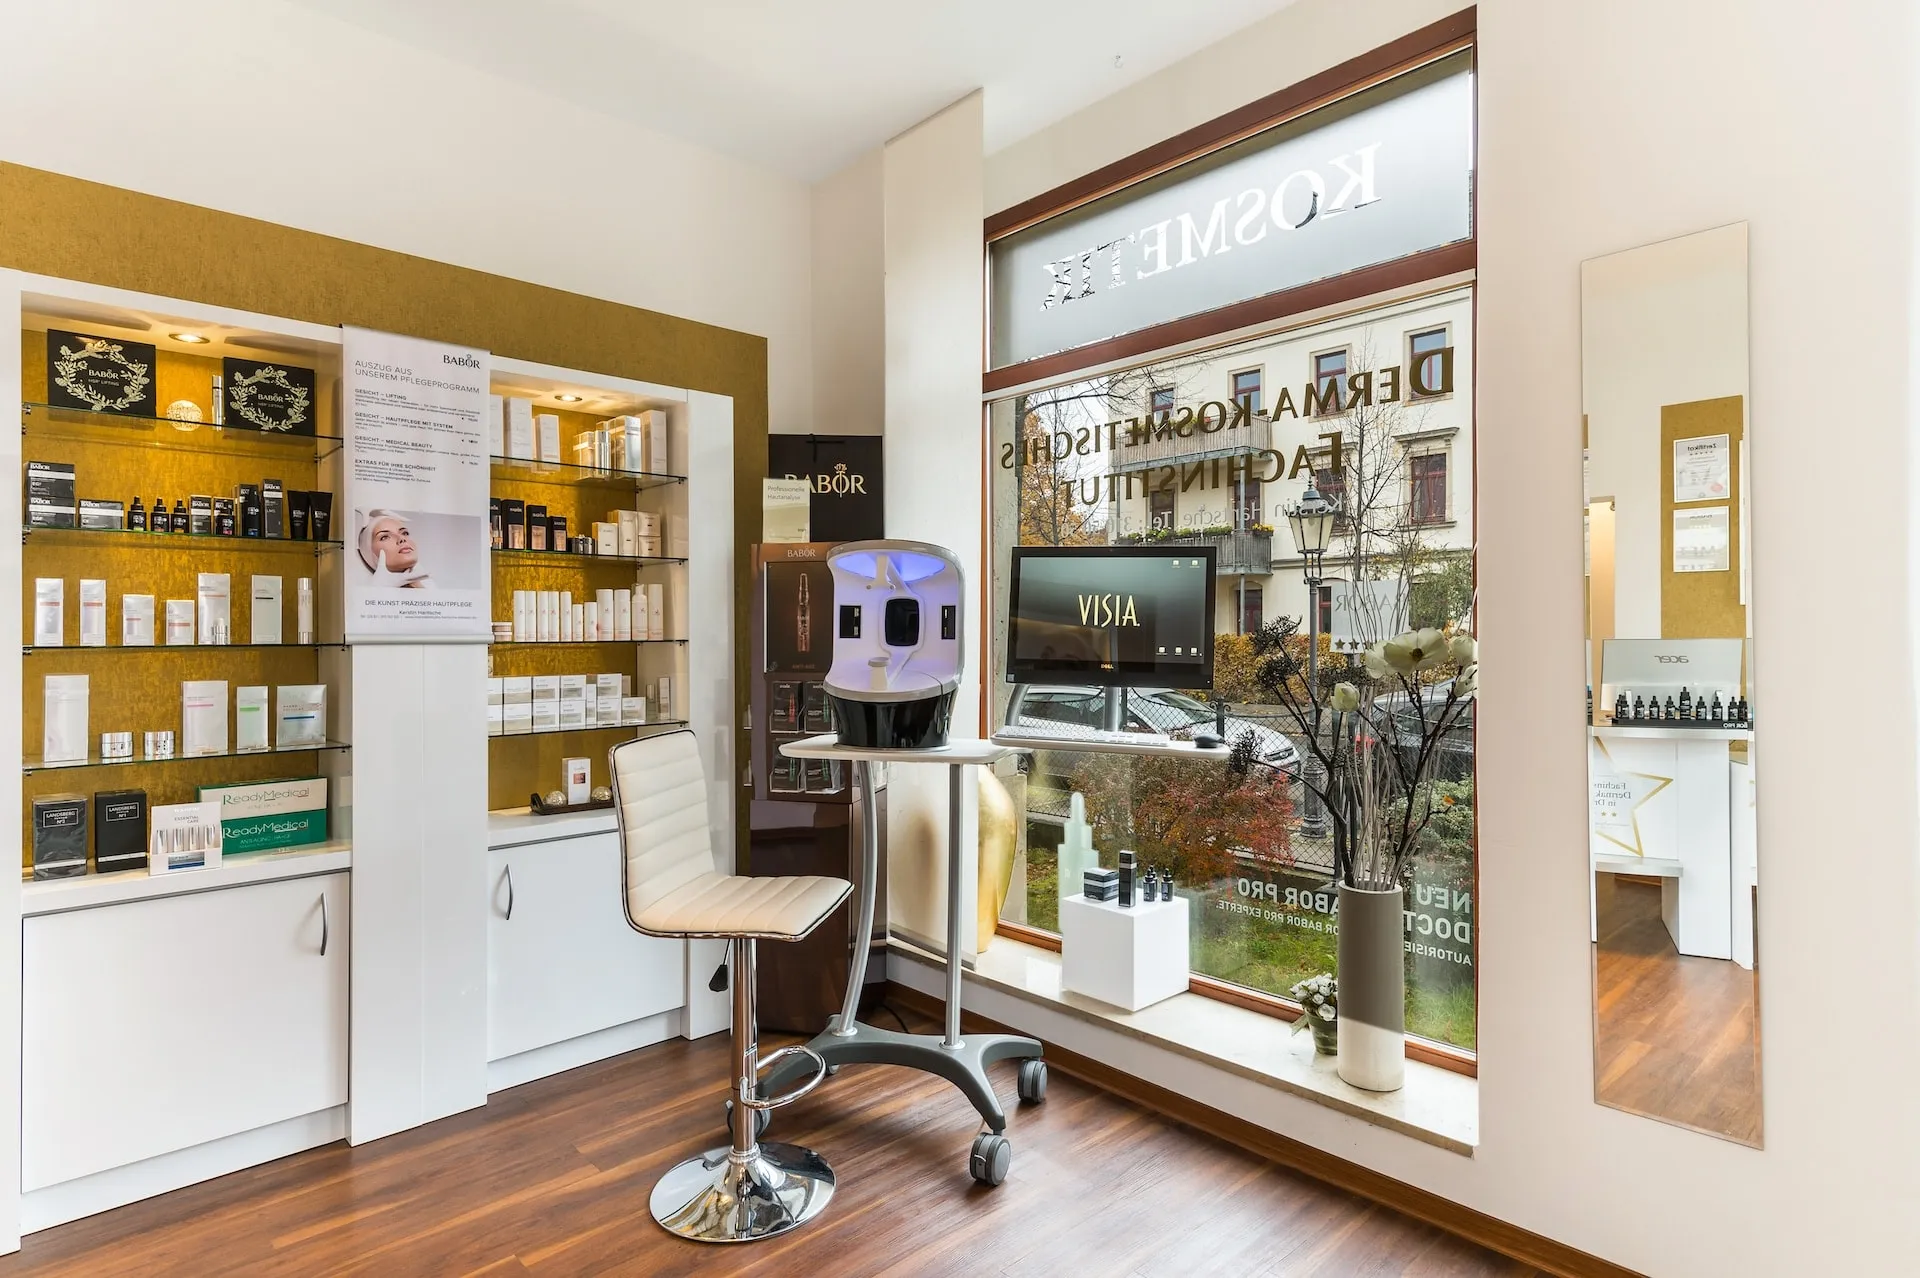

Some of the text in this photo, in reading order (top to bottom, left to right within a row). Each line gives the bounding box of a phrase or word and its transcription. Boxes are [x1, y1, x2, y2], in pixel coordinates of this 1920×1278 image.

[355, 360, 413, 376] AUSZUG AUS
[443, 354, 481, 369] BABOR
[88, 369, 120, 379] BABOR
[355, 369, 480, 394] UNSEREM PFLEGEPROGRAMM
[355, 388, 407, 401] GESICHT LIFTING
[355, 411, 380, 419] GESICHT
[385, 439, 410, 447] MEDICAL
[787, 547, 816, 558] BABOR
[223, 787, 310, 805] ReadyMedical
[222, 819, 309, 839] ReadyMedical
